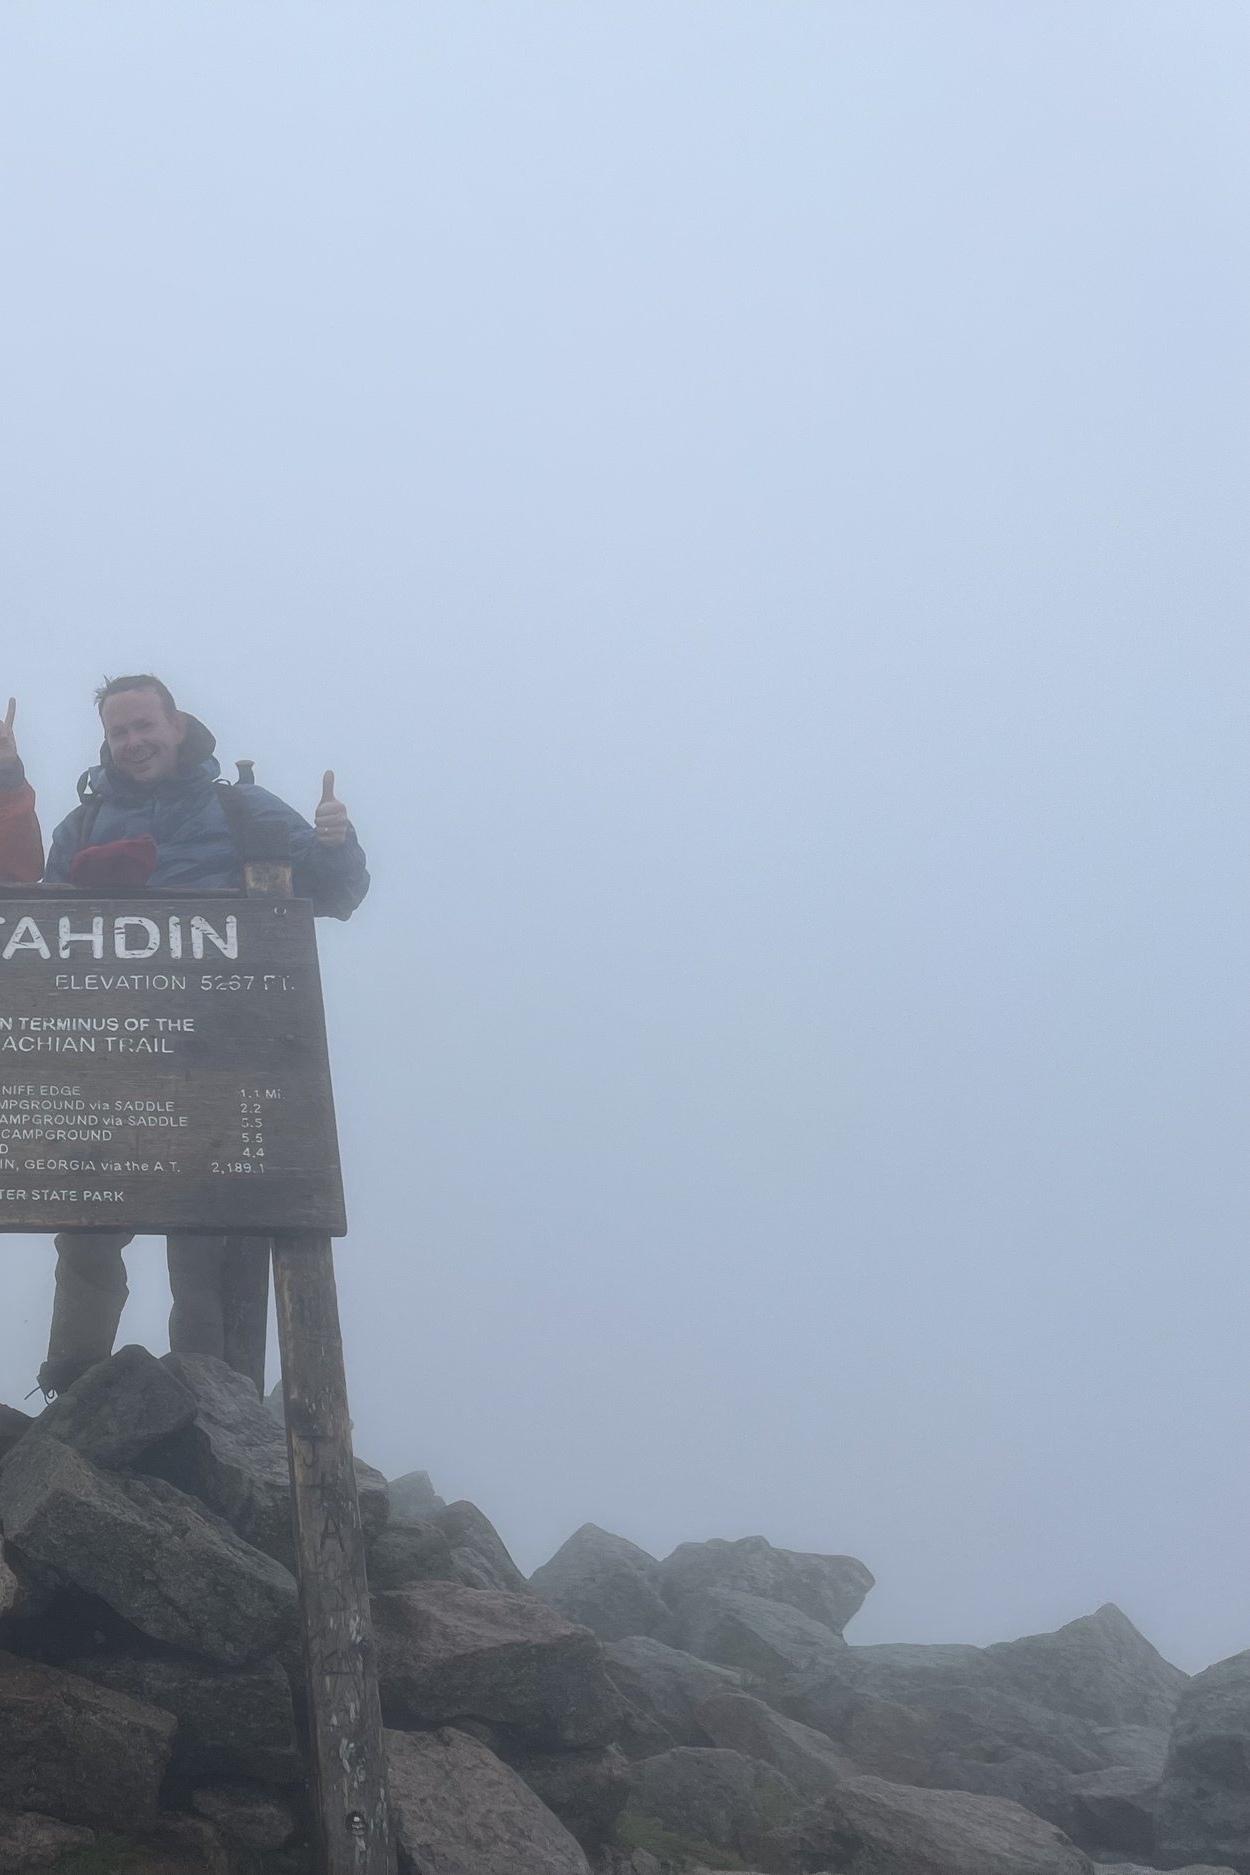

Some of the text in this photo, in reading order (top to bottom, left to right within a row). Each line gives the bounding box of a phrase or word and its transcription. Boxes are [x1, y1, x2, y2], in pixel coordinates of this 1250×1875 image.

[55, 974, 186, 990] ELEVATION
[18, 1016, 119, 1031] TERMINUS
[124, 1017, 150, 1031] OF
[155, 1018, 195, 1032] THE
[103, 1036, 175, 1053] TRAIL
[40, 1085, 81, 1097] EDGE
[89, 1100, 110, 1111] via
[114, 1100, 175, 1112] SADDLE
[239, 1103, 261, 1114] 2.2
[102, 1116, 123, 1127] via
[127, 1116, 188, 1127] SADDLE
[0, 1129, 112, 1142] CAMPGROUND
[241, 1132, 263, 1143] 5.5
[242, 1147, 265, 1158] 4.4
[24, 1159, 96, 1171] GEORGIA
[100, 1160, 122, 1171] via
[125, 1161, 149, 1172] the
[211, 1162, 265, 1175] 2,189.1
[31, 1189, 78, 1202] STATE
[83, 1190, 125, 1202] PARK
